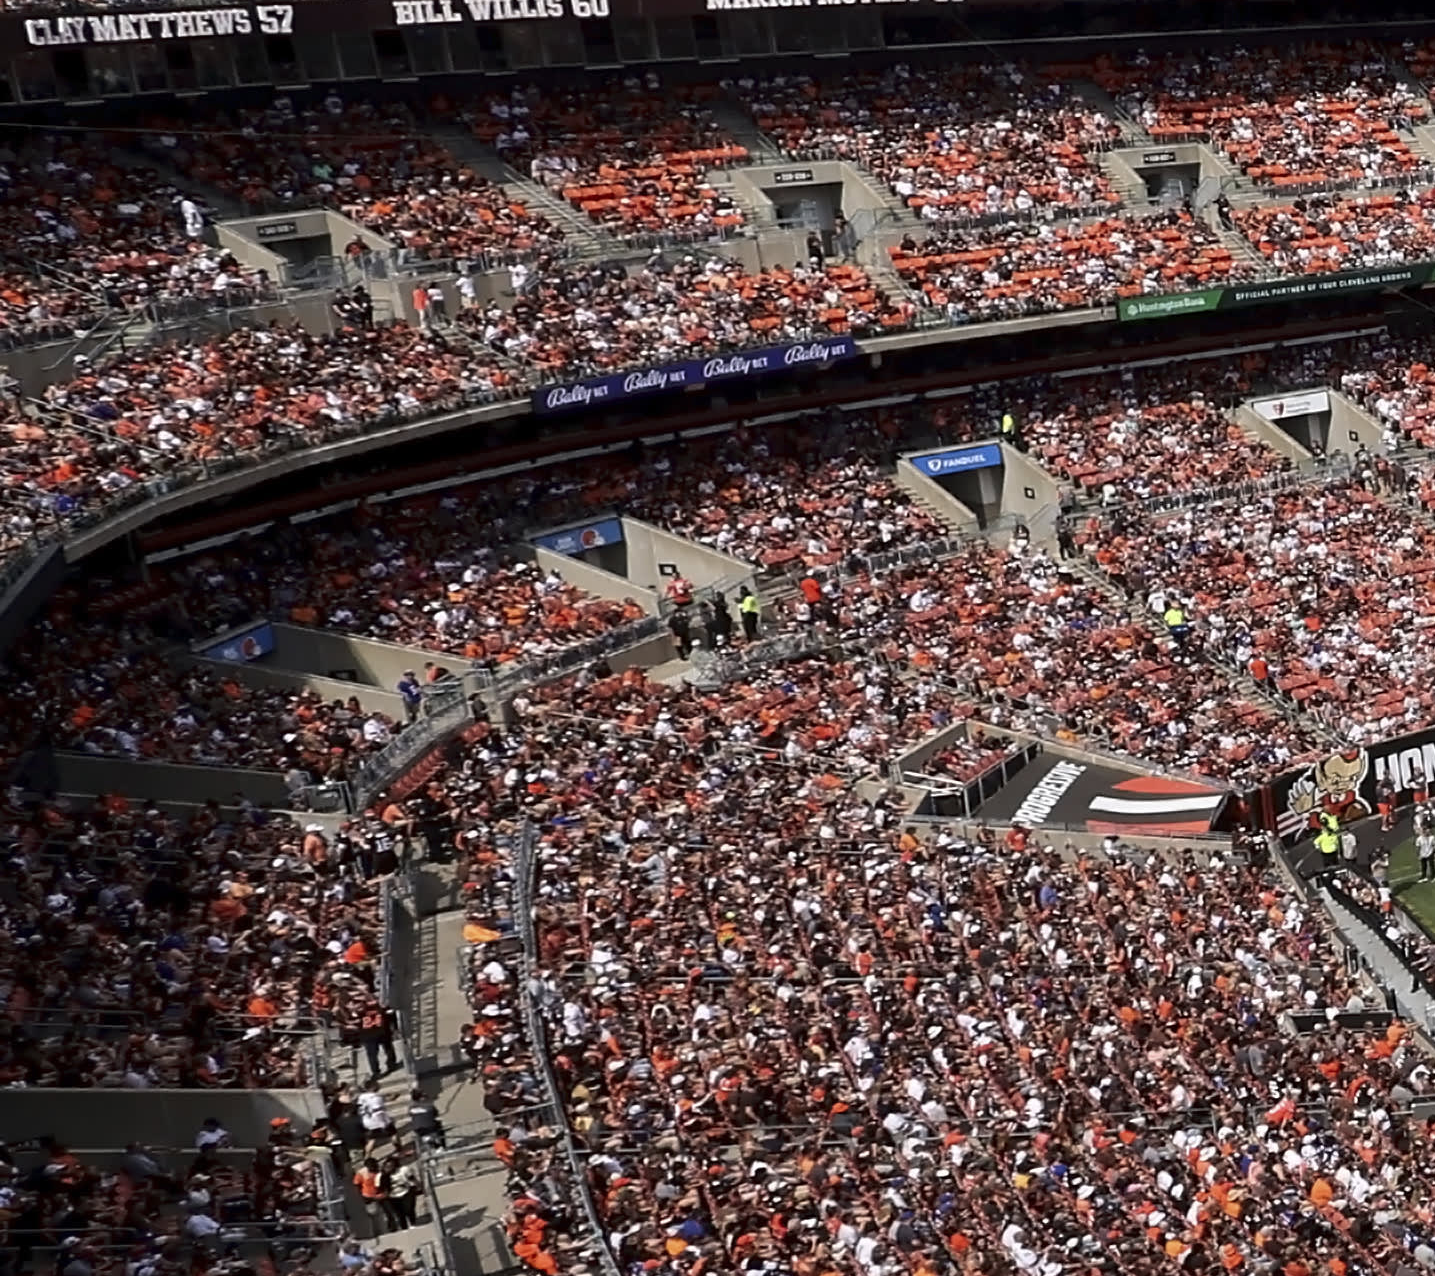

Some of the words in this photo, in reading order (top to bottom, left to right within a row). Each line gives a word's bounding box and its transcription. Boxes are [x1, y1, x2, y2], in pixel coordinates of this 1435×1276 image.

[393, 0, 462, 24] BILL
[25, 17, 85, 45] CLAY
[88, 9, 251, 42] MATTHEWS
[257, 5, 293, 33] 57
[1236, 289, 1270, 300] OFFICIAL
[1272, 285, 1306, 296] PARTNER
[1308, 284, 1316, 292] OF
[1339, 276, 1380, 287] CLEVELAND
[785, 343, 830, 364] Bally
[703, 356, 749, 377] Bally
[625, 370, 668, 392] Bally
[547, 386, 592, 408] Bally
[939, 452, 978, 465] FANDUEL
